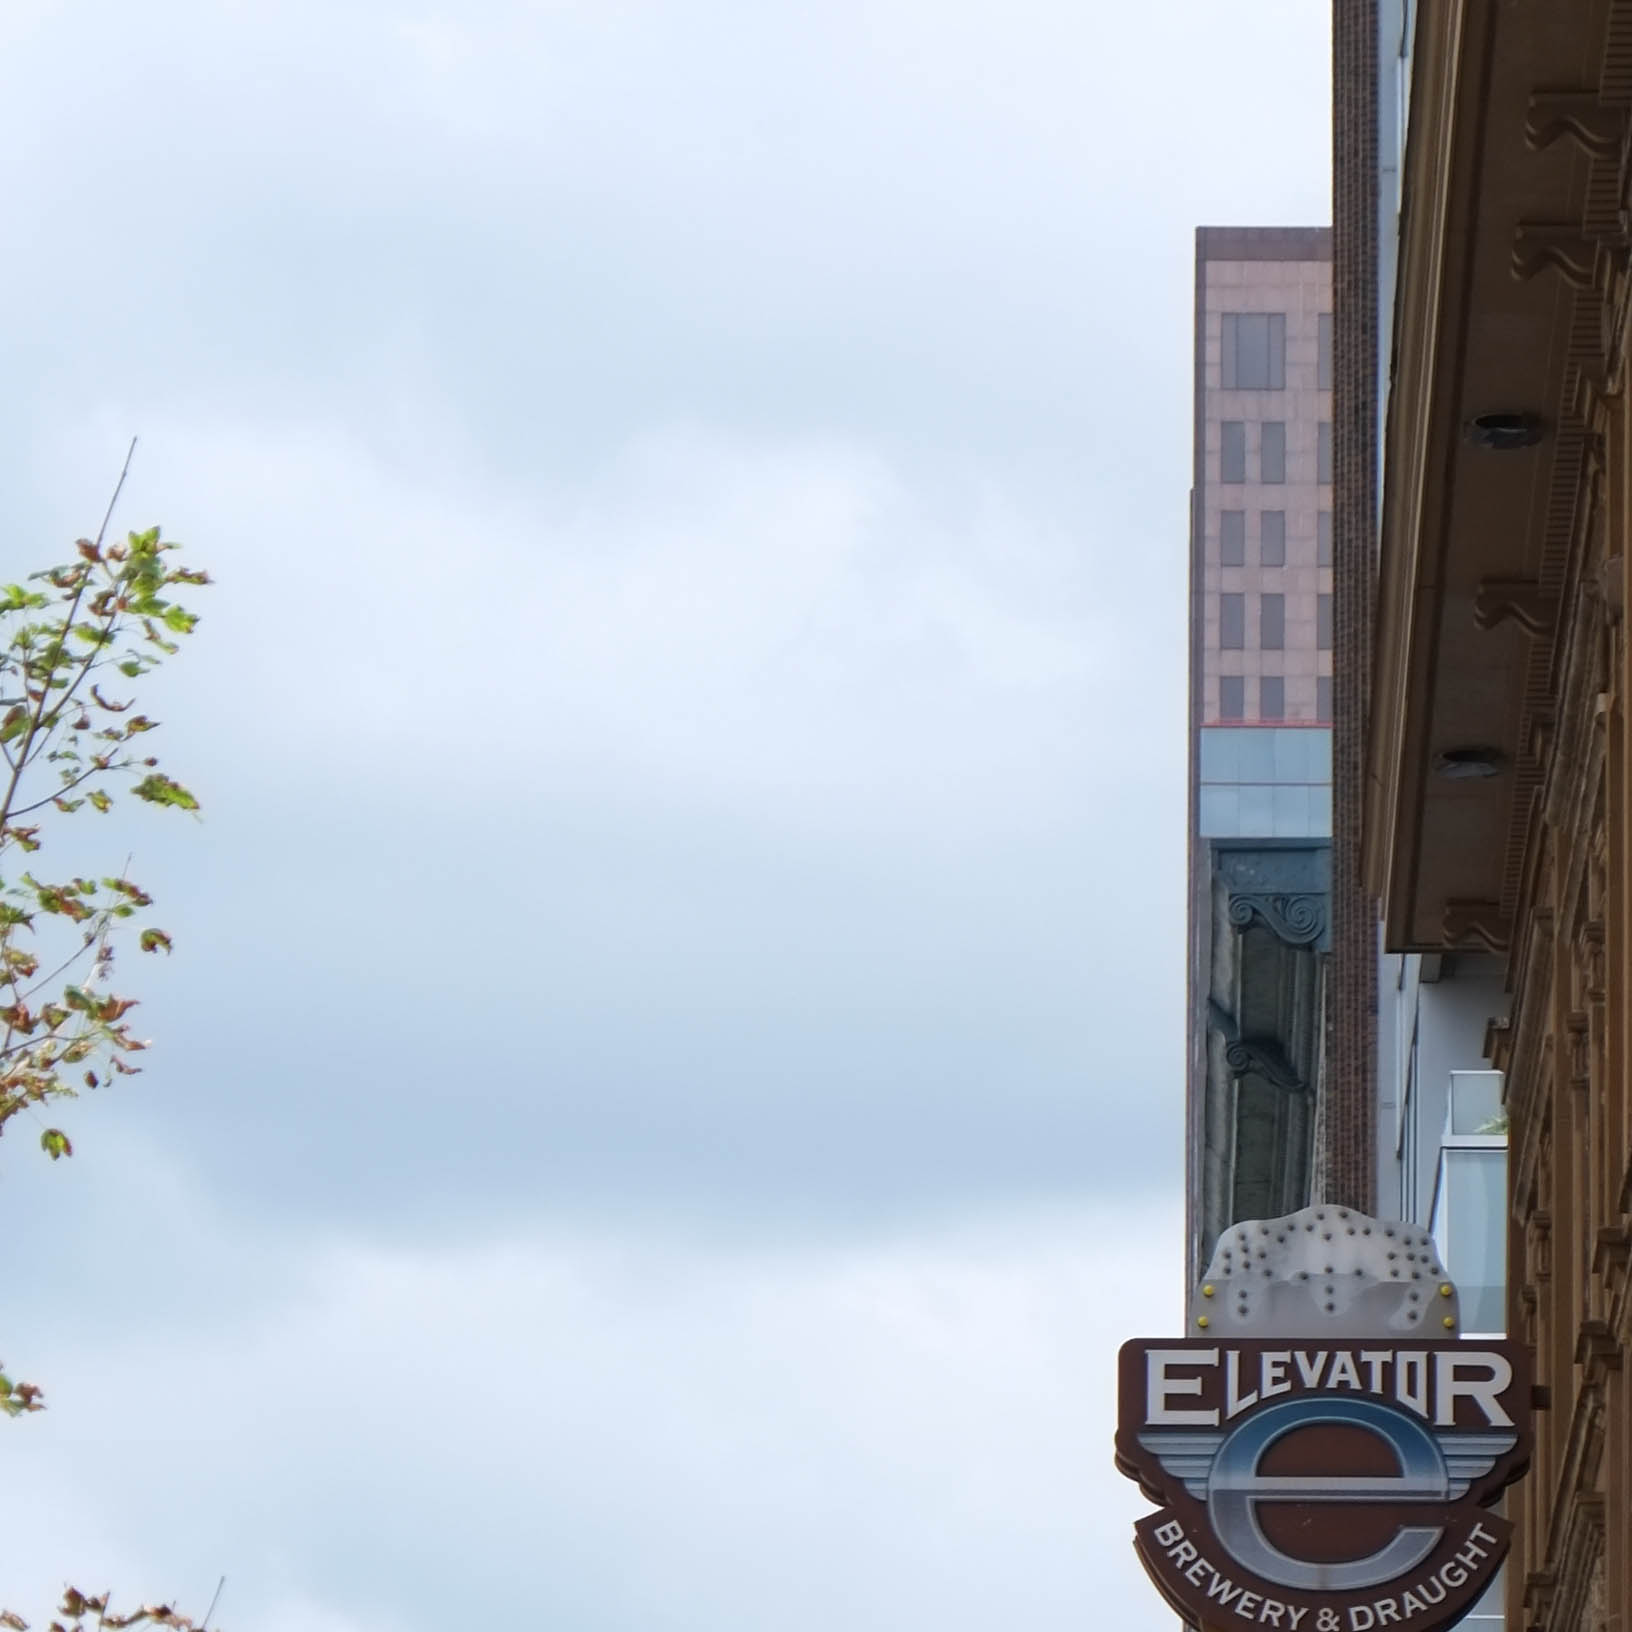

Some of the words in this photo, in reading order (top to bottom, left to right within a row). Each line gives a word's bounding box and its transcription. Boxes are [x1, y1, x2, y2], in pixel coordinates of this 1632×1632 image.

[1143, 1346, 1517, 1429] ELEVATOR
[1152, 1518, 1310, 1632] BREWERY
[1316, 1606, 1341, 1632] &
[1349, 1521, 1499, 1632] DRAUGHT
